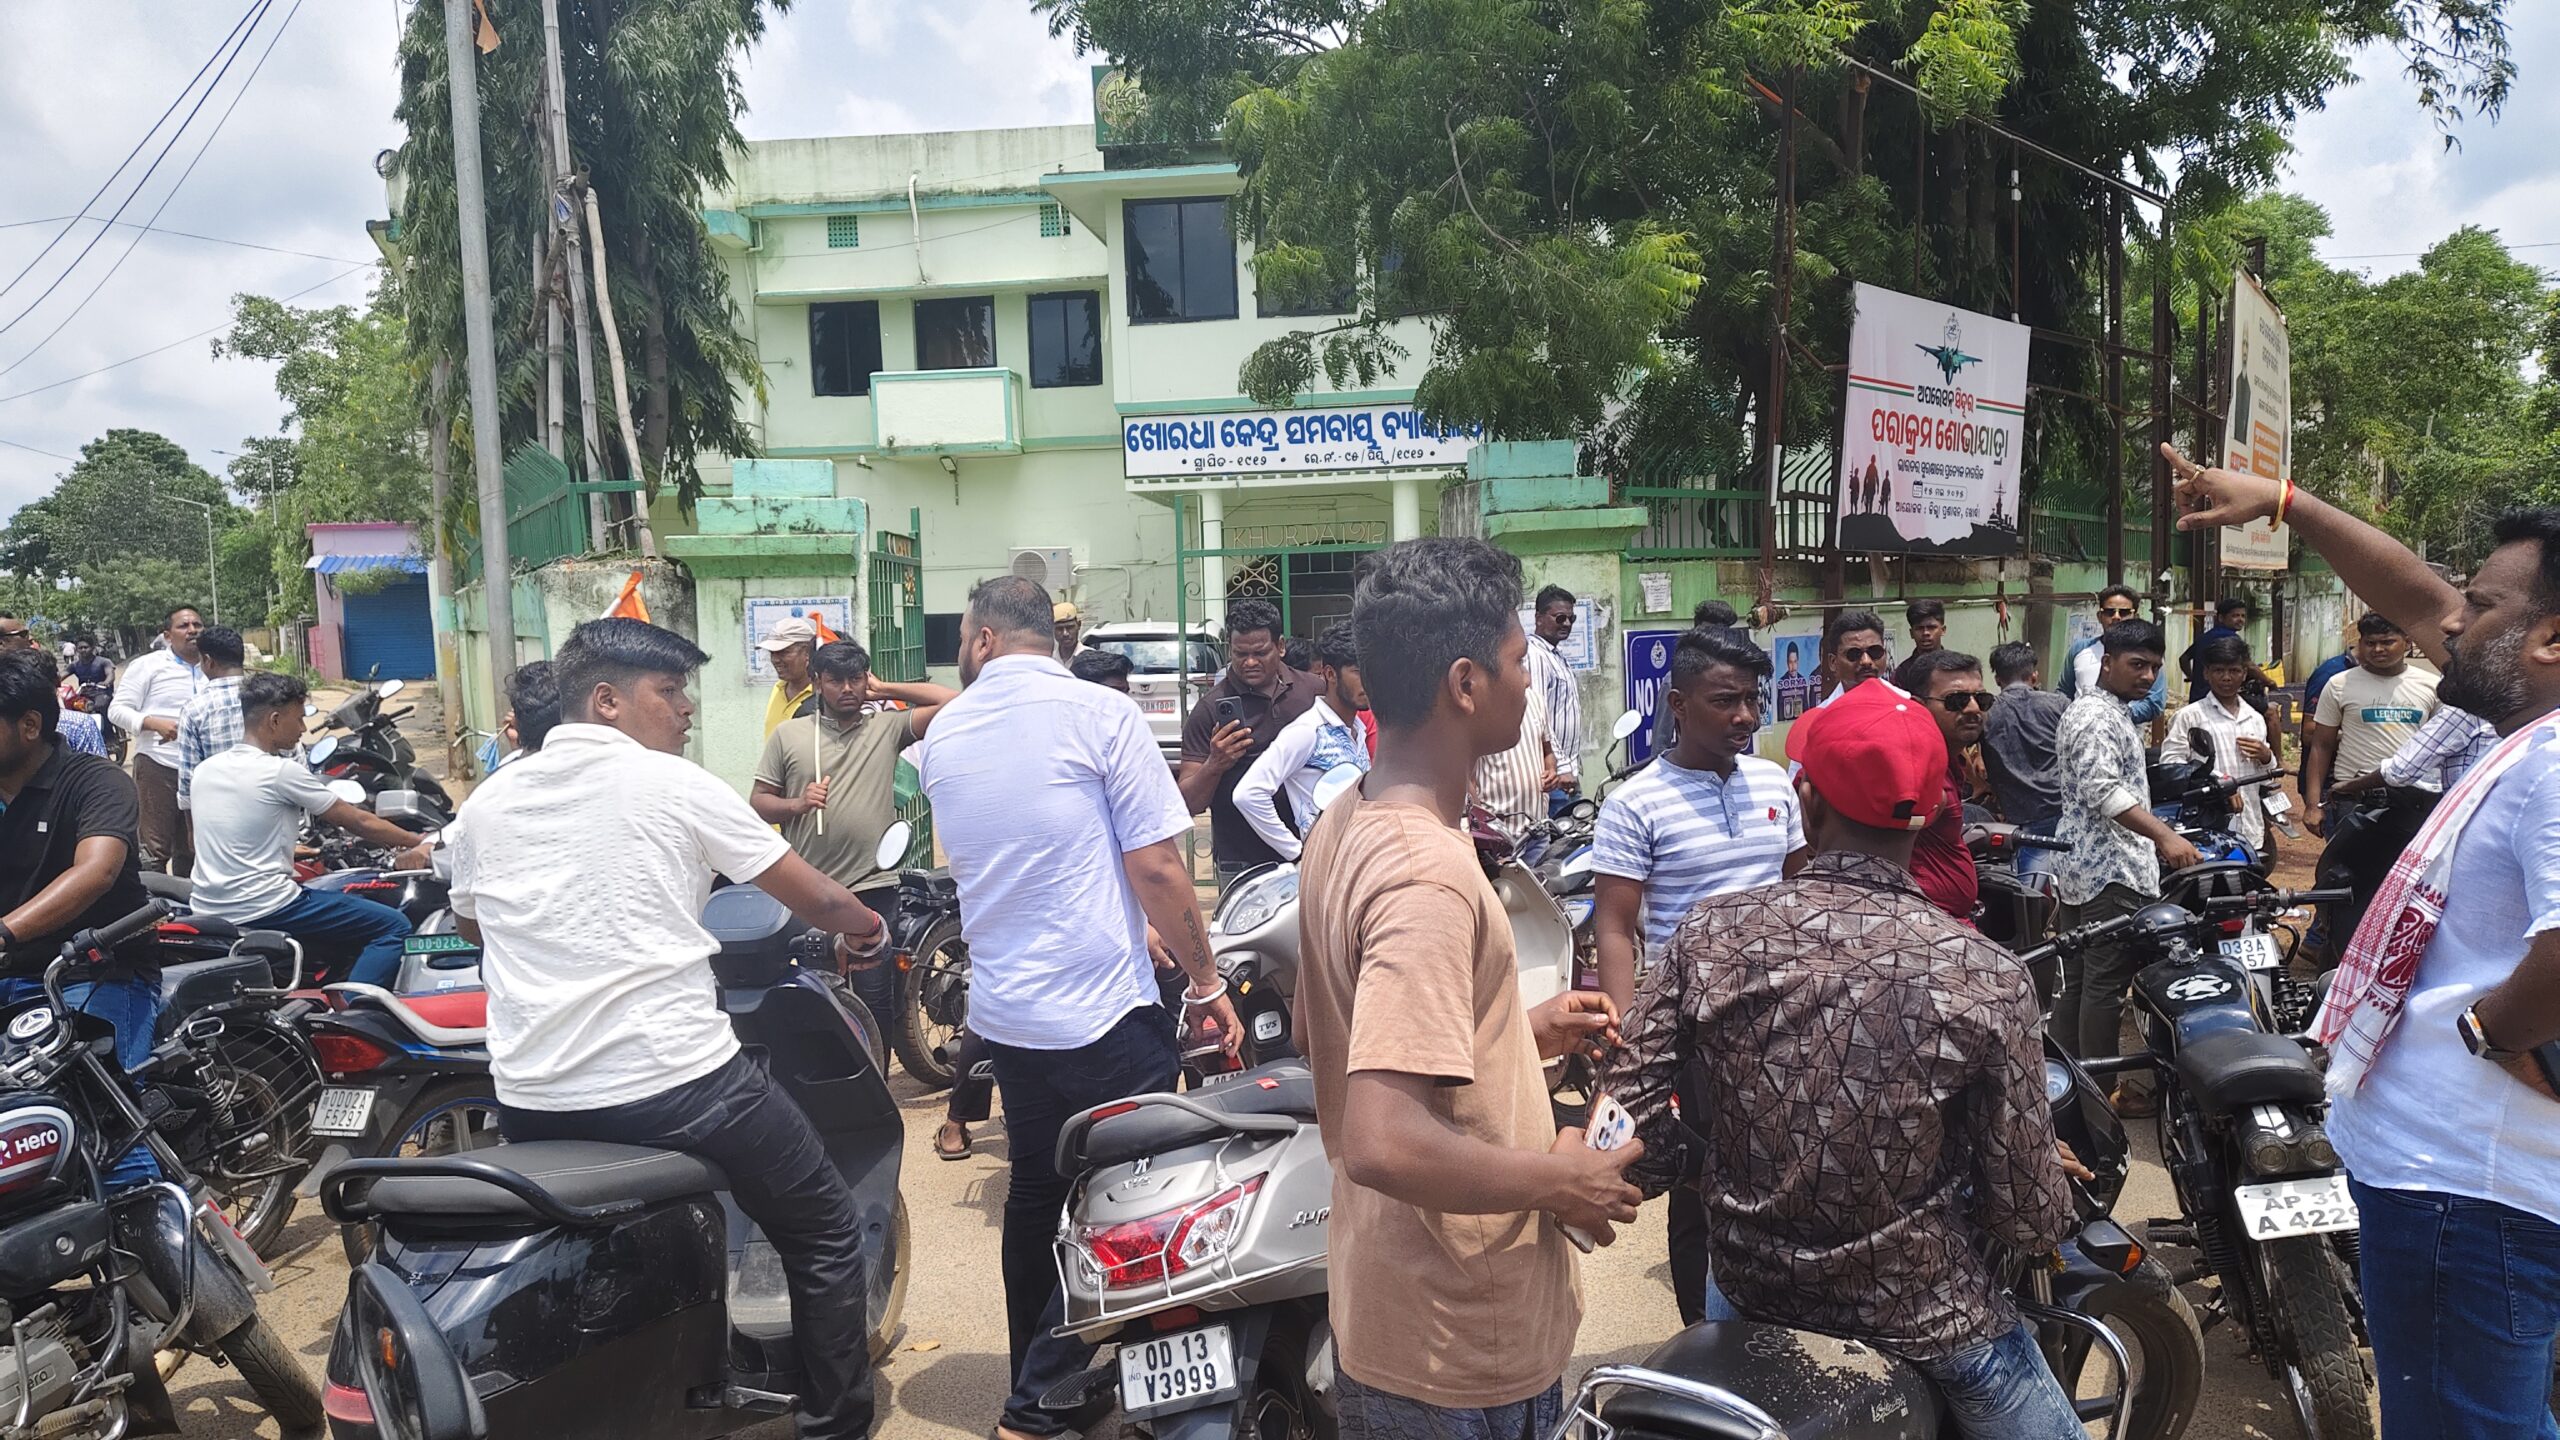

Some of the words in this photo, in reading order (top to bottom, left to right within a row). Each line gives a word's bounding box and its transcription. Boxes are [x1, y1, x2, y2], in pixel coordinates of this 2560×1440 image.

[1872, 408, 1932, 455] ପରାକ୍ରମ
[1935, 418, 2009, 465] ଶୋଭାଯାତ୍ରା
[1234, 525, 1338, 548] KHURDA
[1635, 677, 1654, 718] NO
[1259, 1019, 1278, 1031] TVS
[323, 1109, 362, 1128] F5297
[15, 1129, 58, 1154] Hero
[1121, 1175, 1152, 1191] TVS
[2264, 1195, 2301, 1211] AP
[2311, 1191, 2342, 1206] 31
[2258, 1215, 2280, 1234] A
[1145, 1340, 1172, 1371] OD
[1181, 1332, 1208, 1363] 13
[1144, 1362, 1216, 1402] V3999
